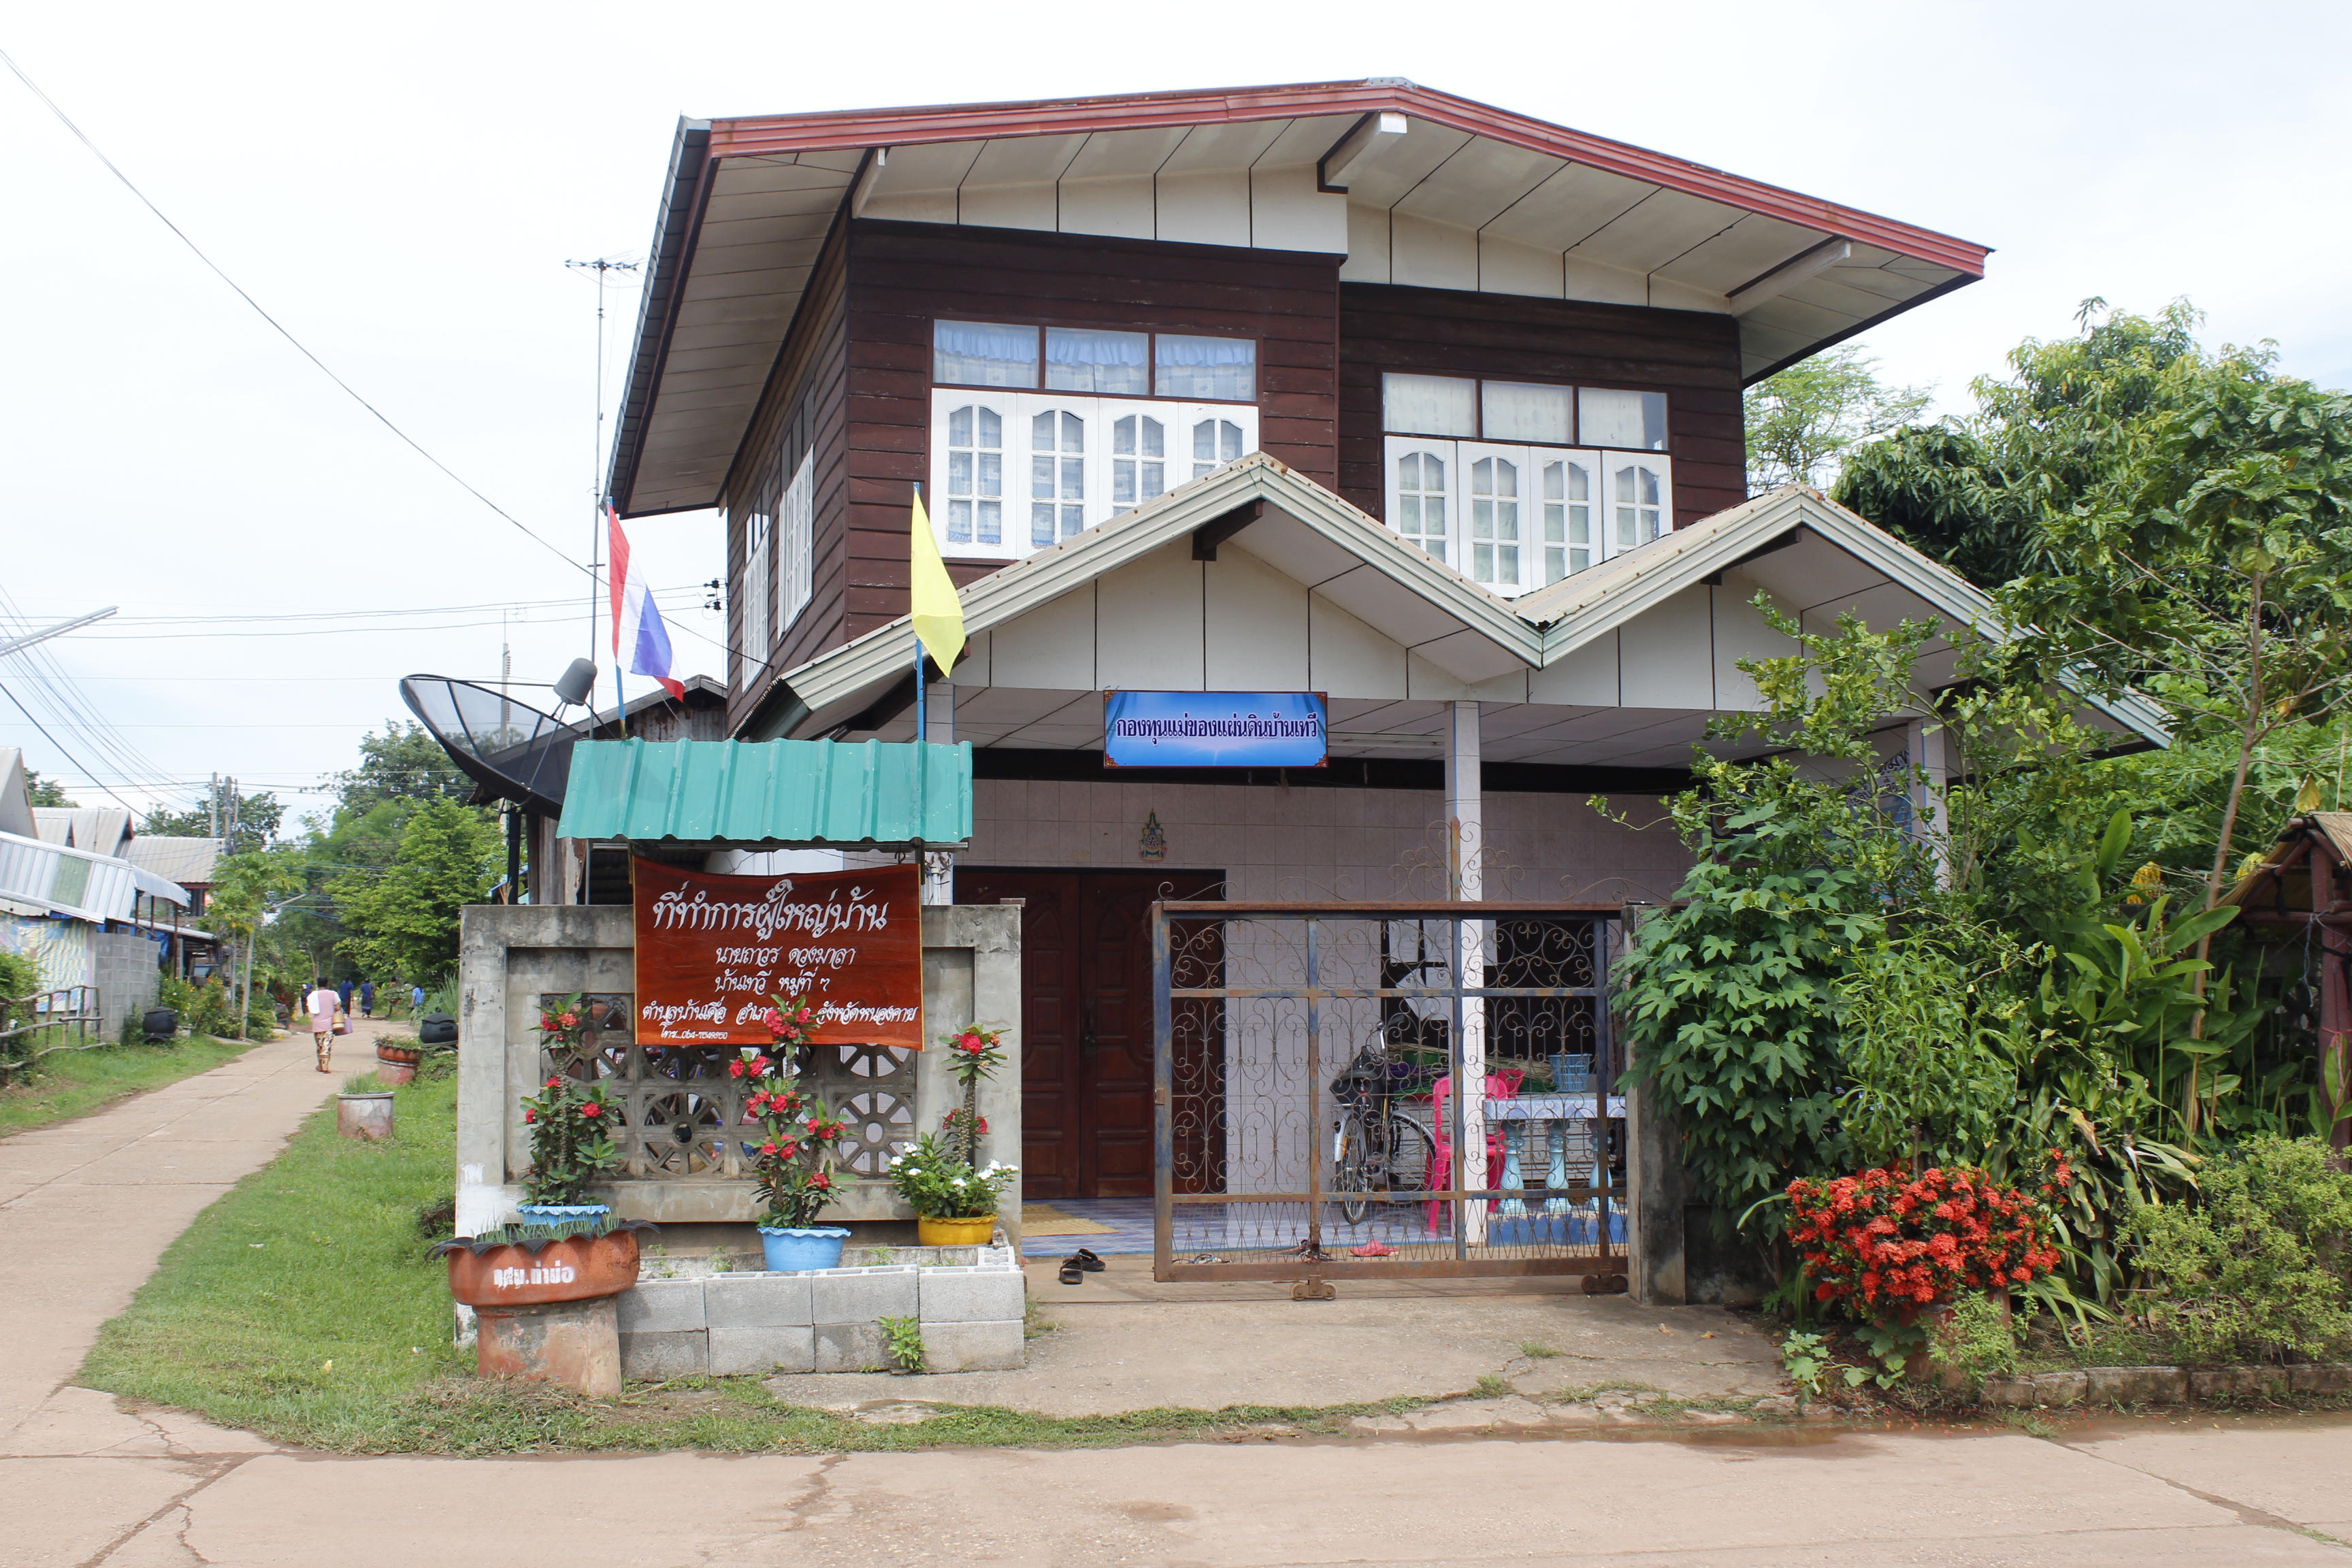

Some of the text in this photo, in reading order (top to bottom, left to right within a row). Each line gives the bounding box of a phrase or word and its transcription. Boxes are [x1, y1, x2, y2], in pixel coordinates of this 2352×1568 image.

[1115, 712, 1319, 746] กองทุนแม่ของแผ่นดินบ้านเทวี
[653, 879, 889, 943] ที่ทำการผู้ใหญ่บ้าน
[715, 945, 856, 970] นายถาวร ดวงมาลา
[715, 966, 831, 998] บ้านเทวี หมู่ที่ ๗
[642, 996, 728, 1025] ตำบลบ้านเดื่อ
